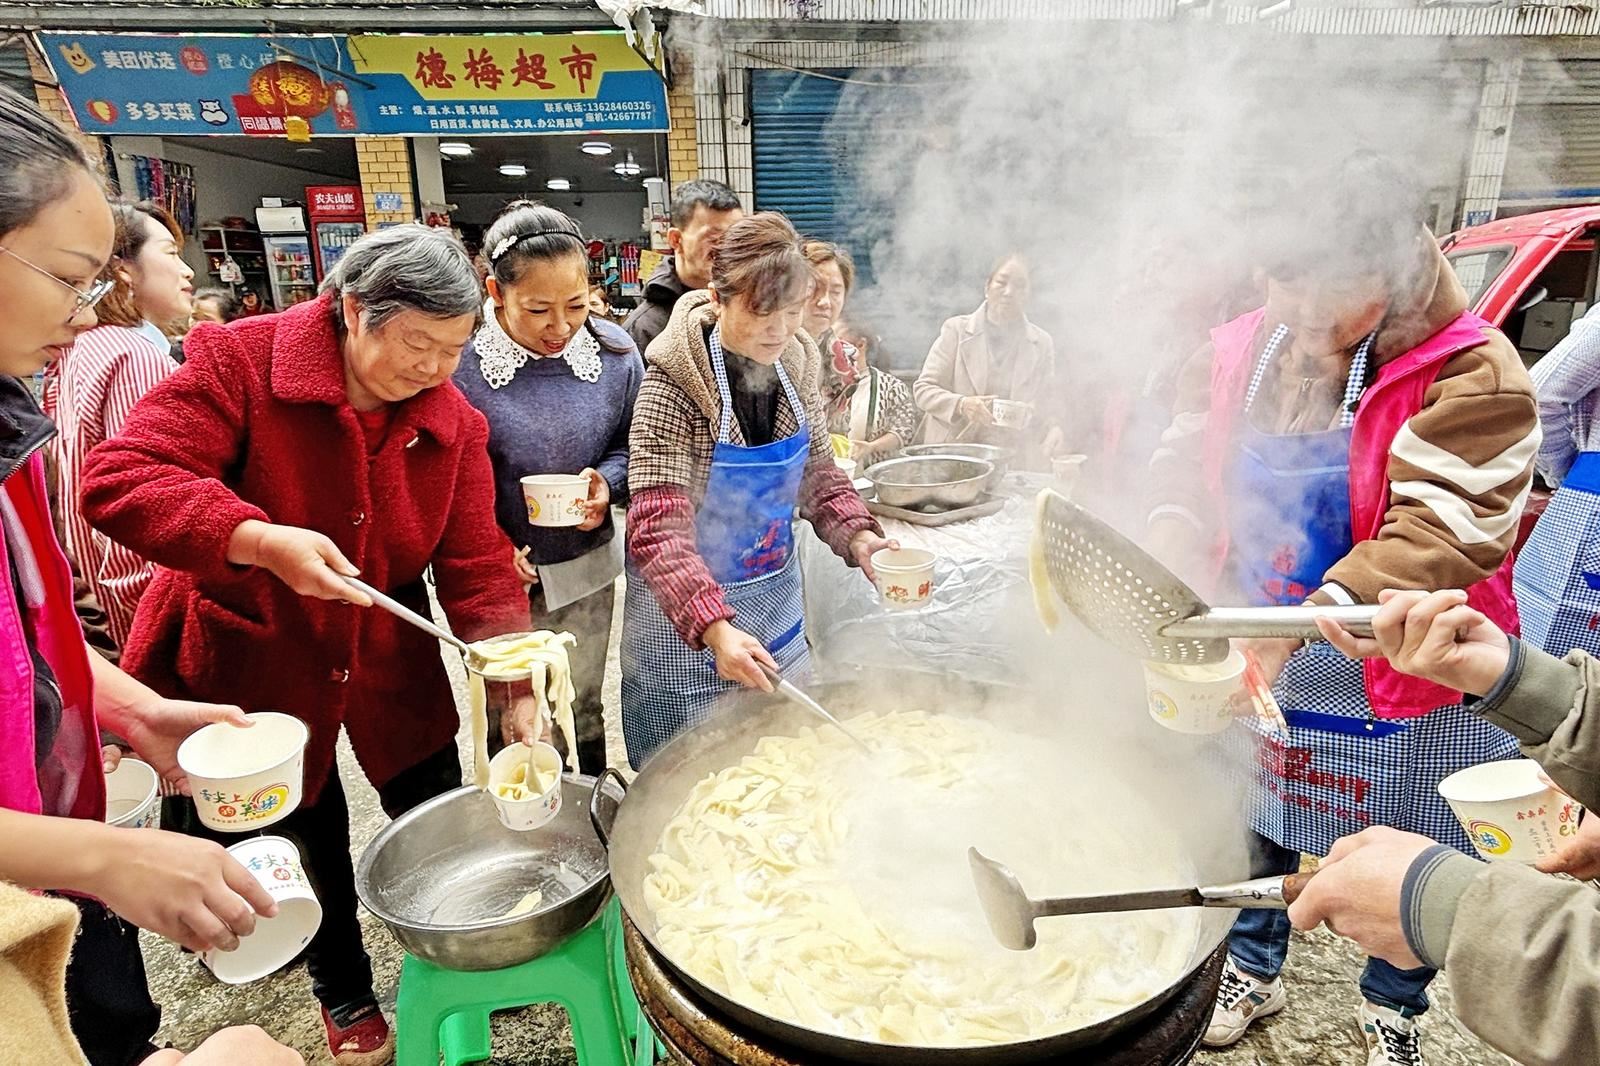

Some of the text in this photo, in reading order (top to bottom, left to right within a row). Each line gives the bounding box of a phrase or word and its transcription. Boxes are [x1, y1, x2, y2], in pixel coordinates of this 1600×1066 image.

[103, 50, 177, 70] 美团优选
[415, 44, 597, 93] 德梅超市
[125, 101, 196, 121] 多多买菜
[315, 193, 355, 204] 农夫山泉
